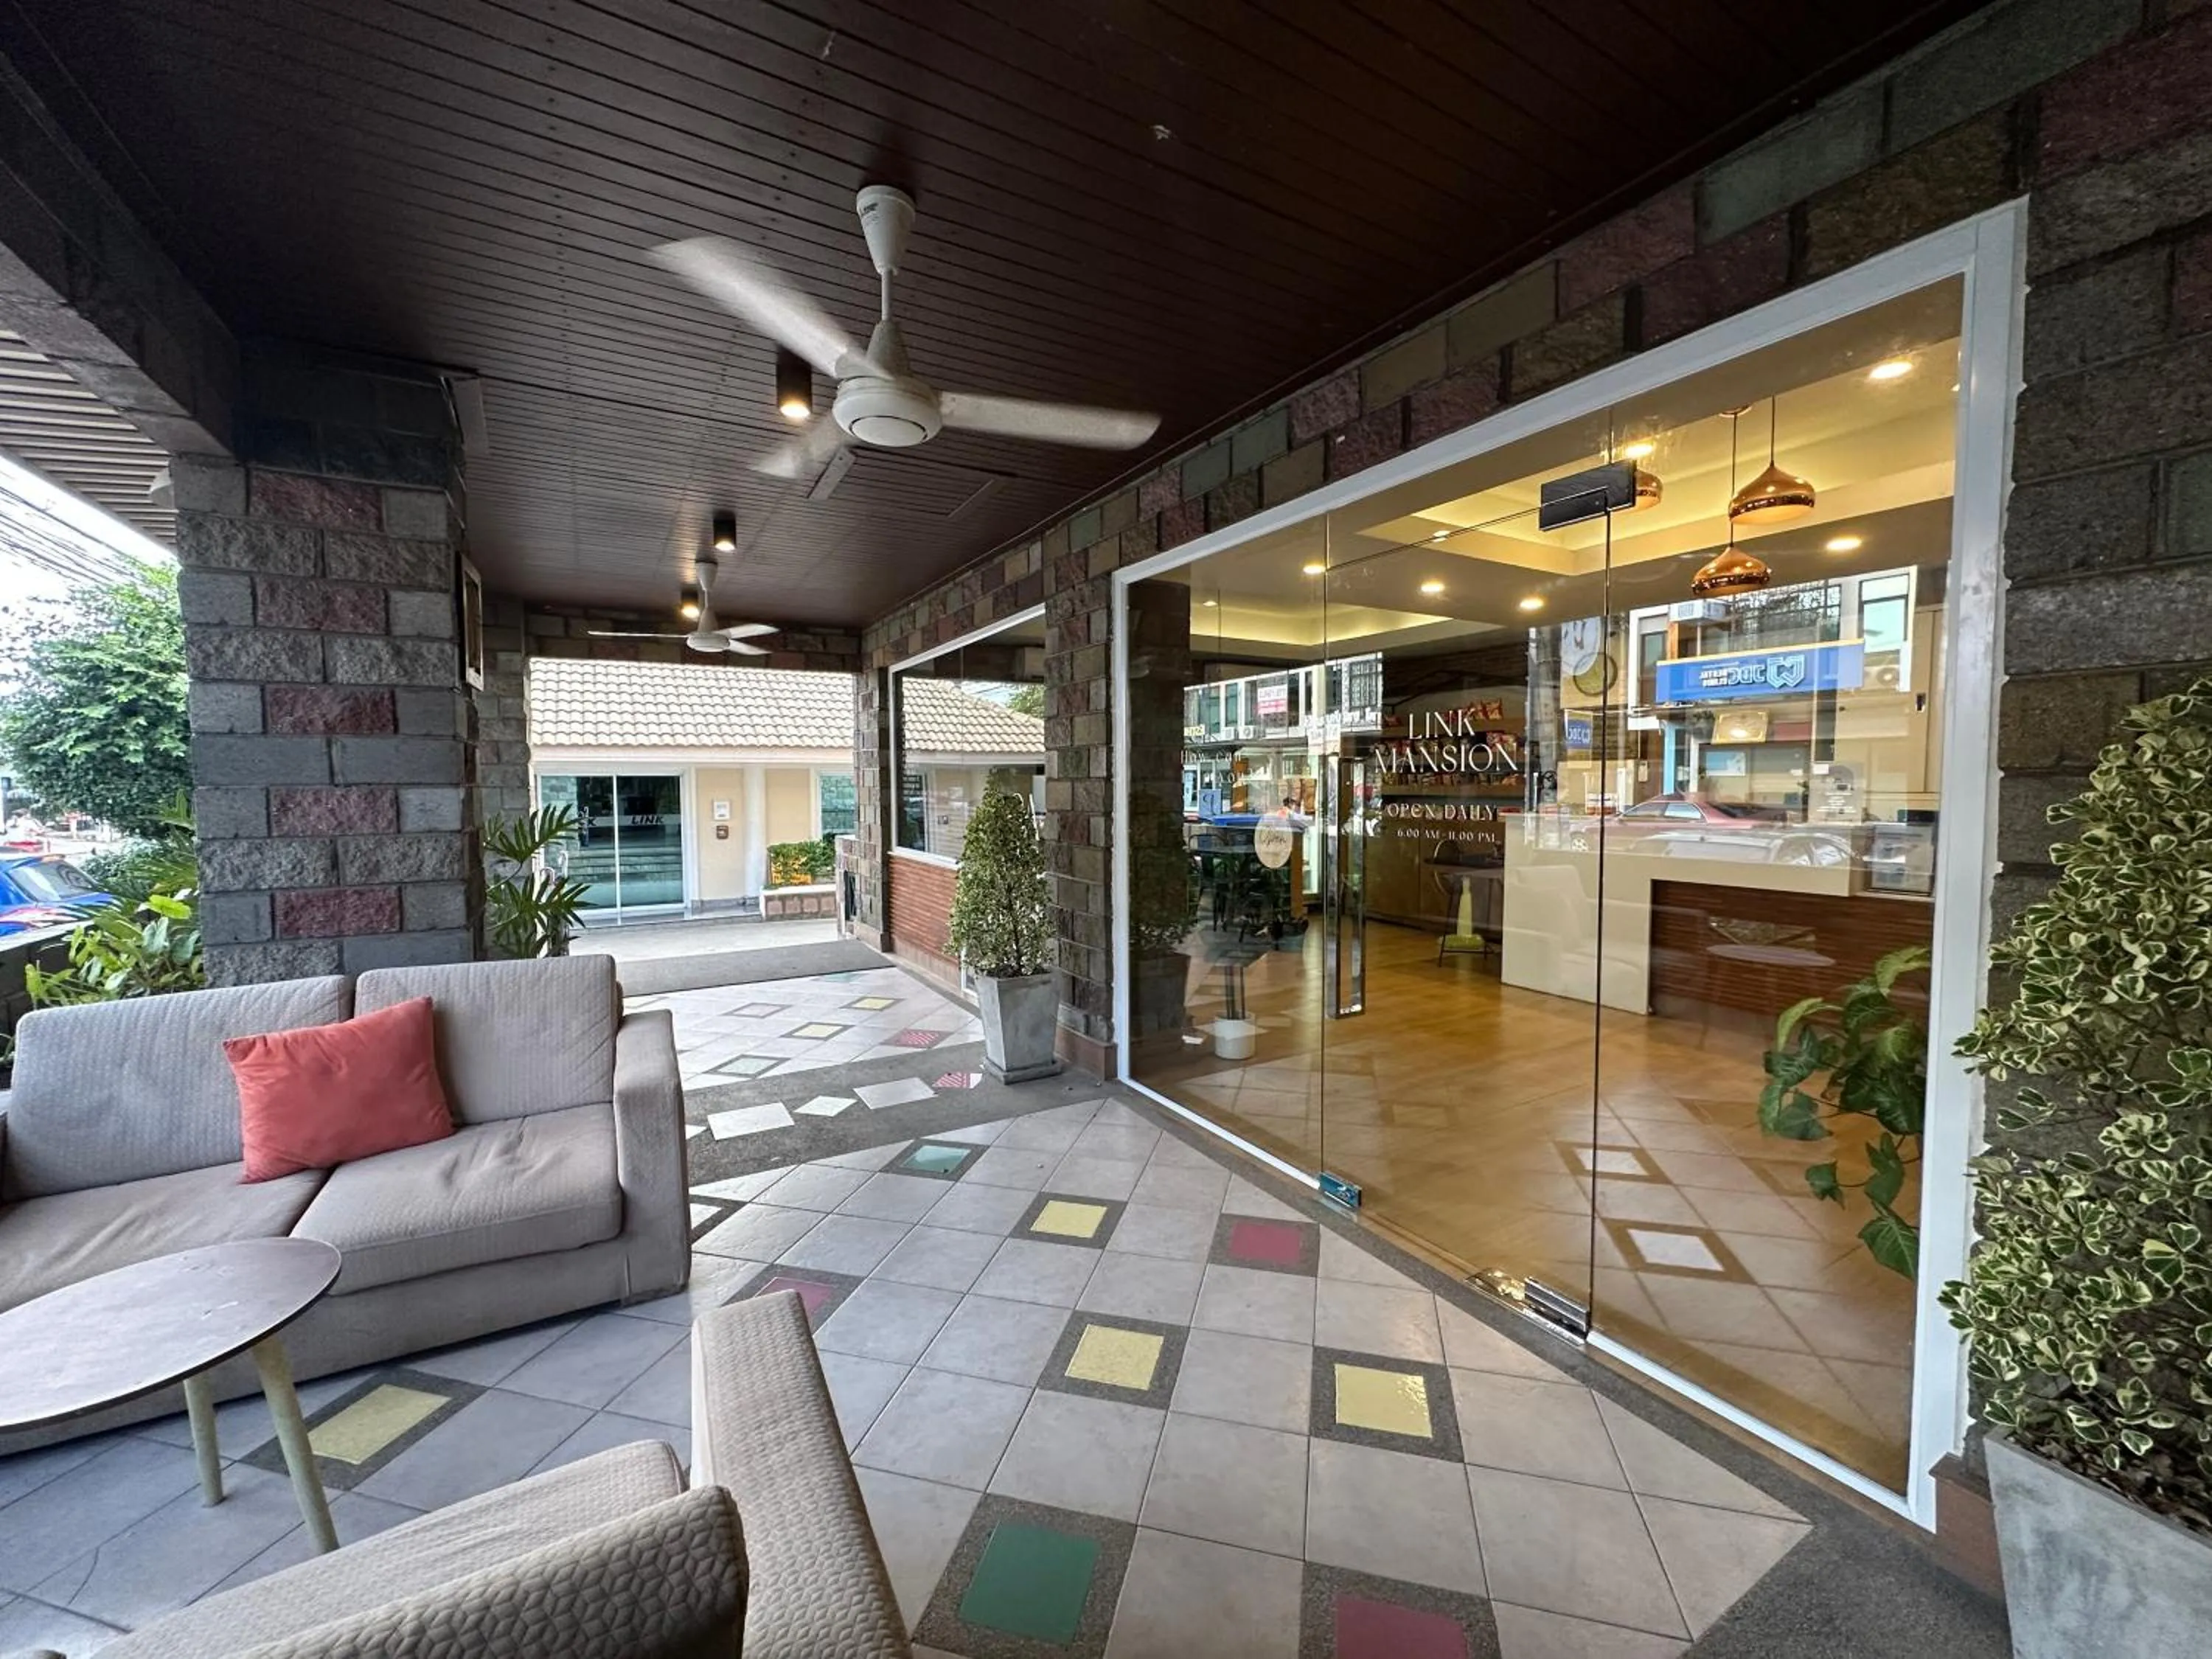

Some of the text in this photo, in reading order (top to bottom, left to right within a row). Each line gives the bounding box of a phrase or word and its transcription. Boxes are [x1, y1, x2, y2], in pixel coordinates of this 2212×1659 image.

[1409, 709, 1475, 740] LINK
[1375, 742, 1518, 773] MANSION
[1386, 803, 1496, 821] OPEN DAILY
[1397, 828, 1420, 838] 6.00
